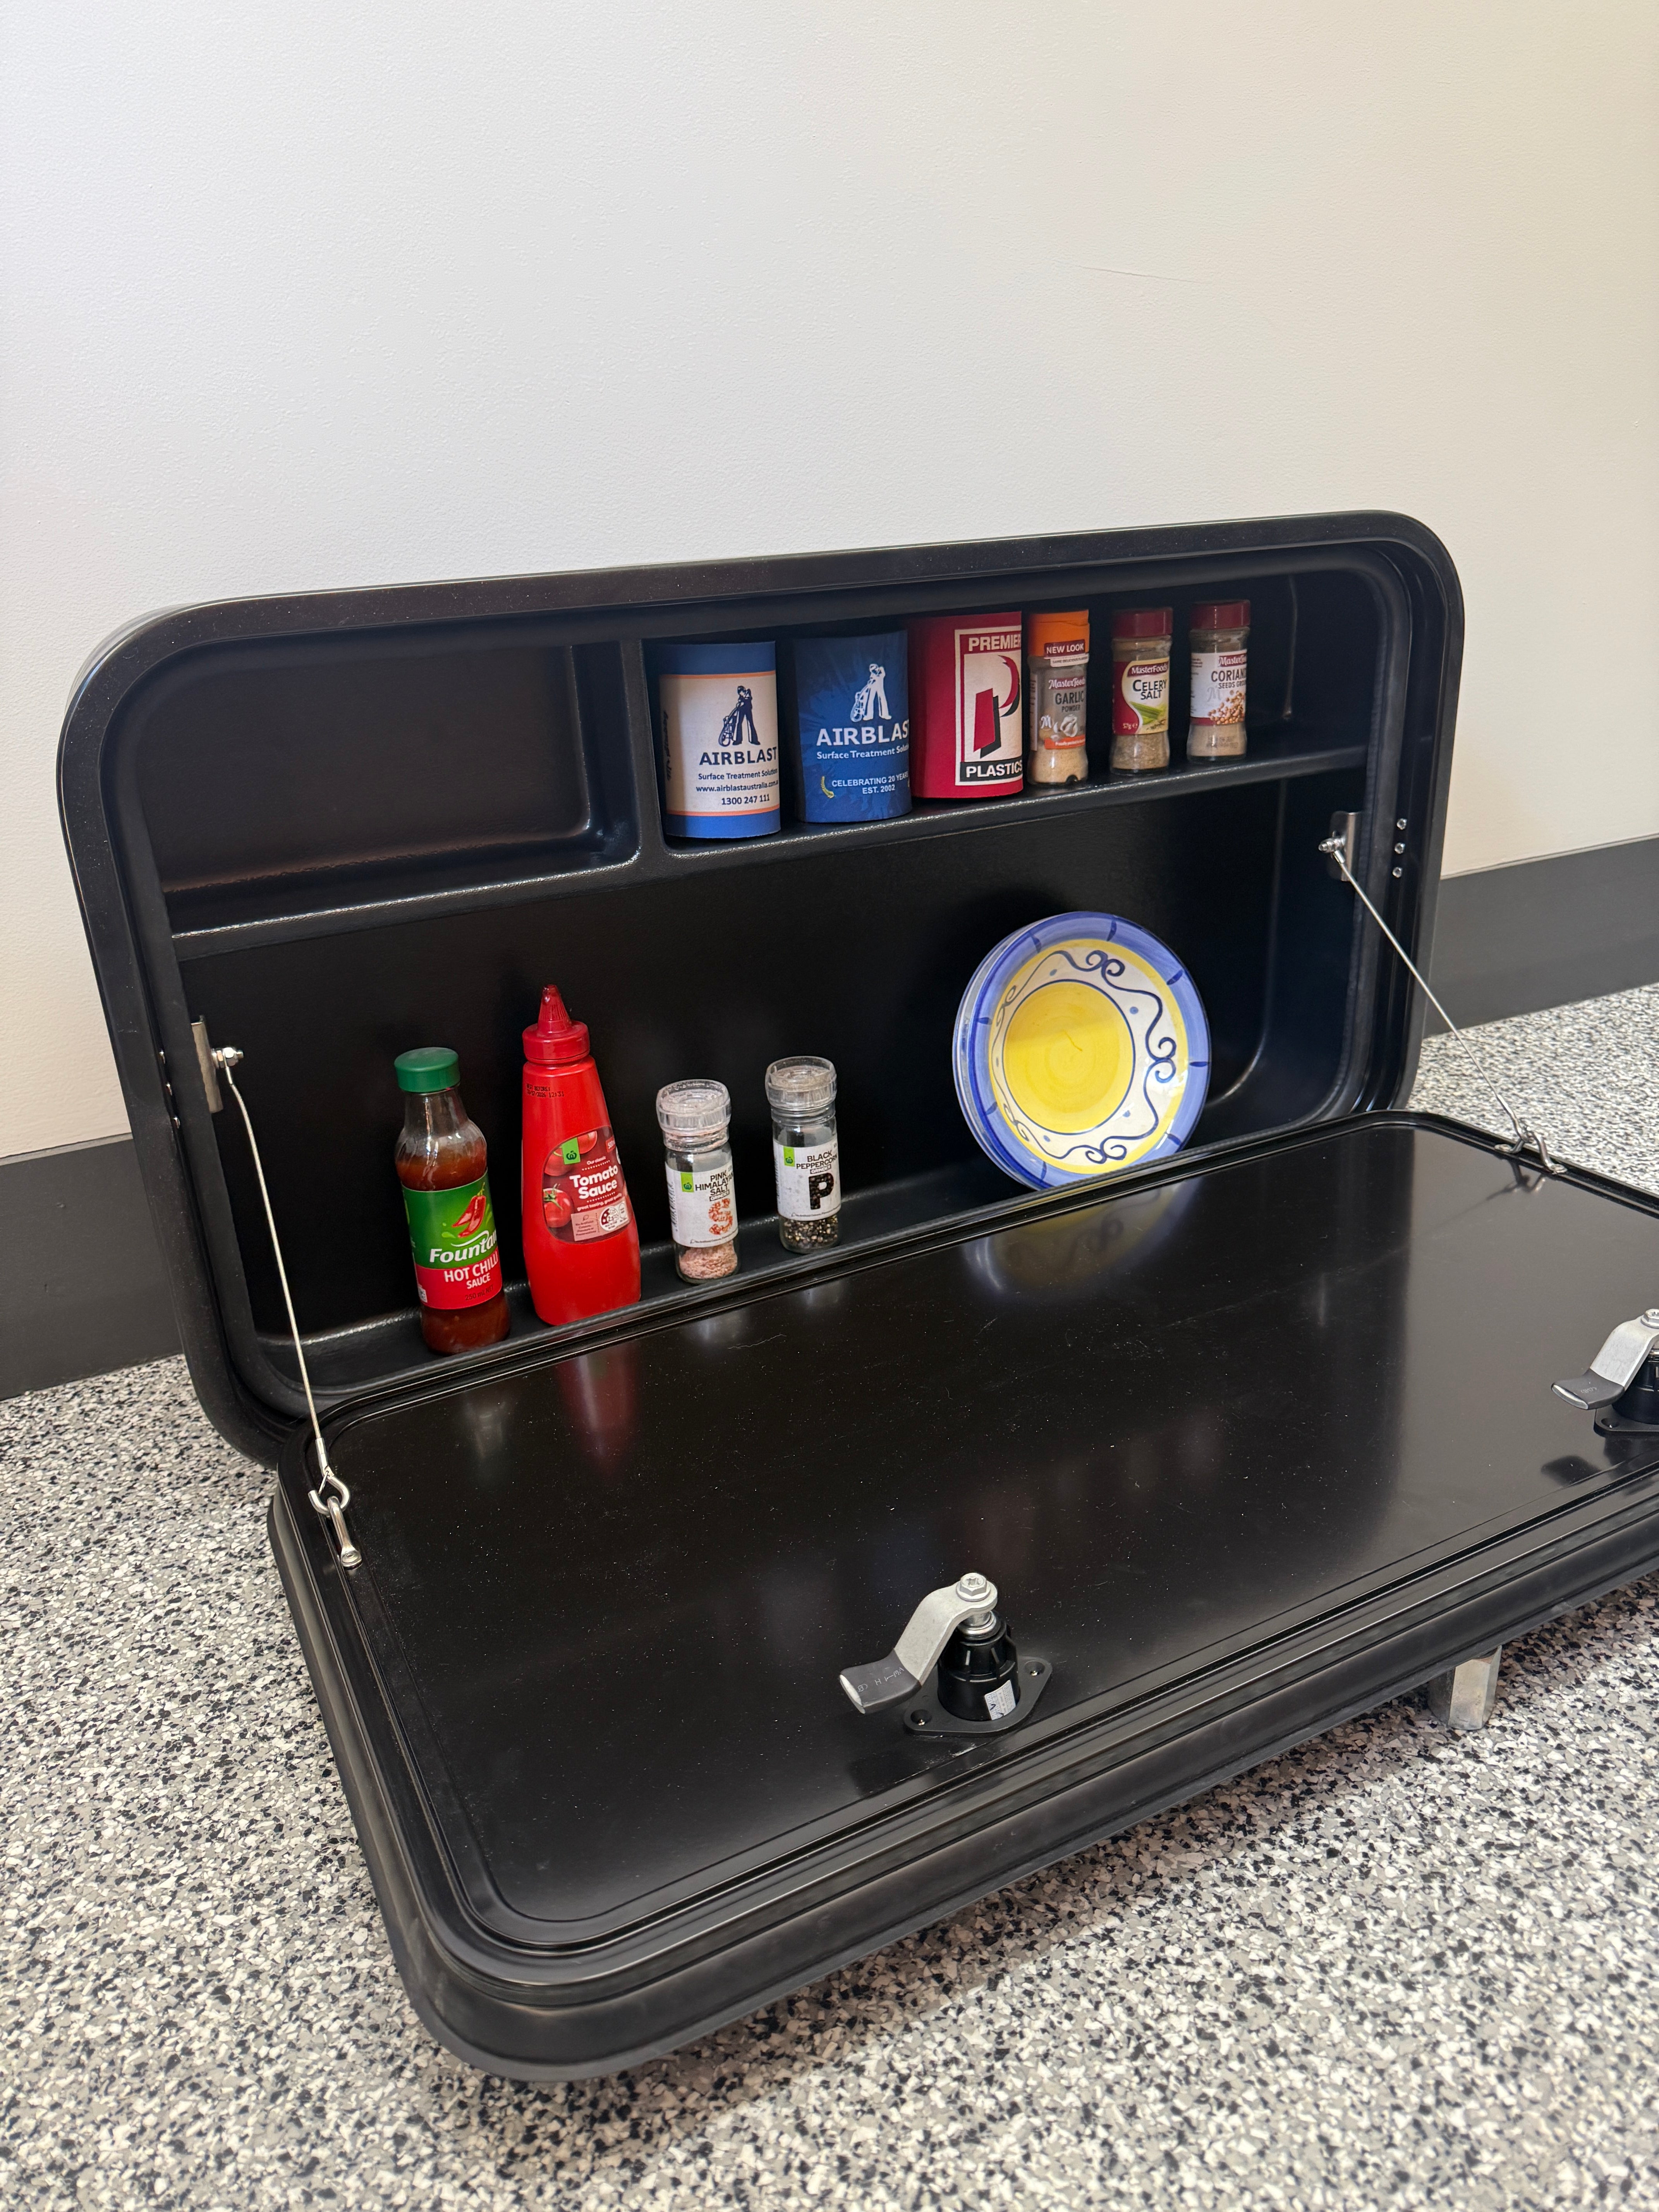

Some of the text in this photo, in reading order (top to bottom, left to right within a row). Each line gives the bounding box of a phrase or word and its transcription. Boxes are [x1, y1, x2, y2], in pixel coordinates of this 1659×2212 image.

[1046, 643, 1084, 654] NEW LOOK
[1131, 663, 1168, 674] MasterFoods
[1055, 690, 1084, 705] GARLIC
[1140, 689, 1162, 700] SALT
[699, 747, 777, 766] AIRBLAST
[817, 751, 849, 759] Surface
[850, 748, 895, 758] Treatment
[726, 771, 760, 780] Treatment
[966, 760, 1022, 778] PLASTICS
[832, 776, 887, 787] CELEBRATING
[881, 784, 895, 793] 2002
[721, 793, 770, 805] 1300 247 111
[807, 1149, 832, 1162] BLACK
[569, 1165, 618, 1188] Tomato
[710, 1170, 726, 1182] PINK
[578, 1180, 617, 1199] Sauce
[710, 1183, 728, 1196] SALT
[809, 1173, 834, 1210] P
[708, 1198, 733, 1235] S
[444, 1250, 498, 1283] HOT CHILLI
[466, 1273, 491, 1289] SAUCE
[465, 1292, 476, 1301] 250
